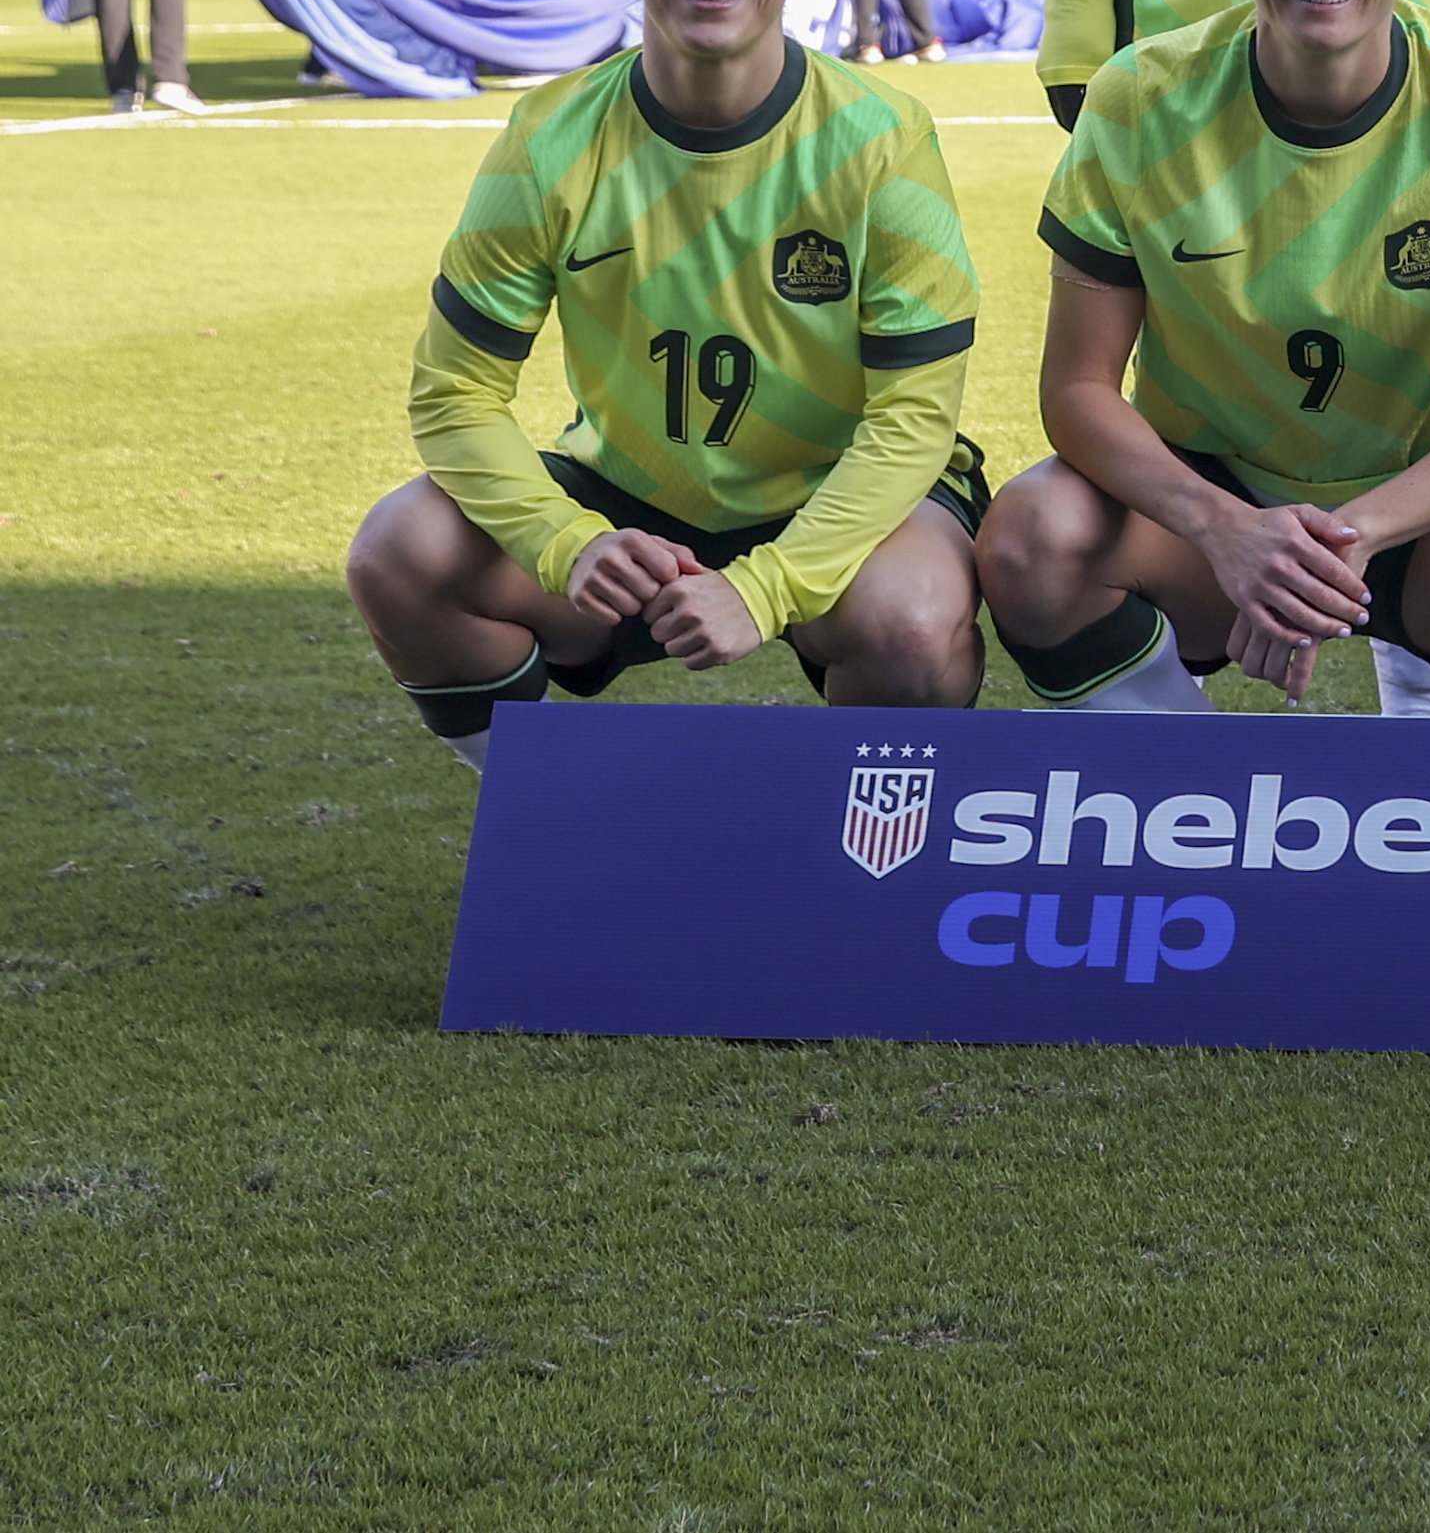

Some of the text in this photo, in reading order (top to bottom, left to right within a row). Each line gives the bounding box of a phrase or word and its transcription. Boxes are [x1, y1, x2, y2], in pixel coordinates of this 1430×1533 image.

[788, 276, 841, 285] AUSTRALIA
[650, 329, 757, 447] 19
[1287, 329, 1344, 412] 9
[855, 773, 928, 814] USA
[937, 891, 1236, 984] cup
